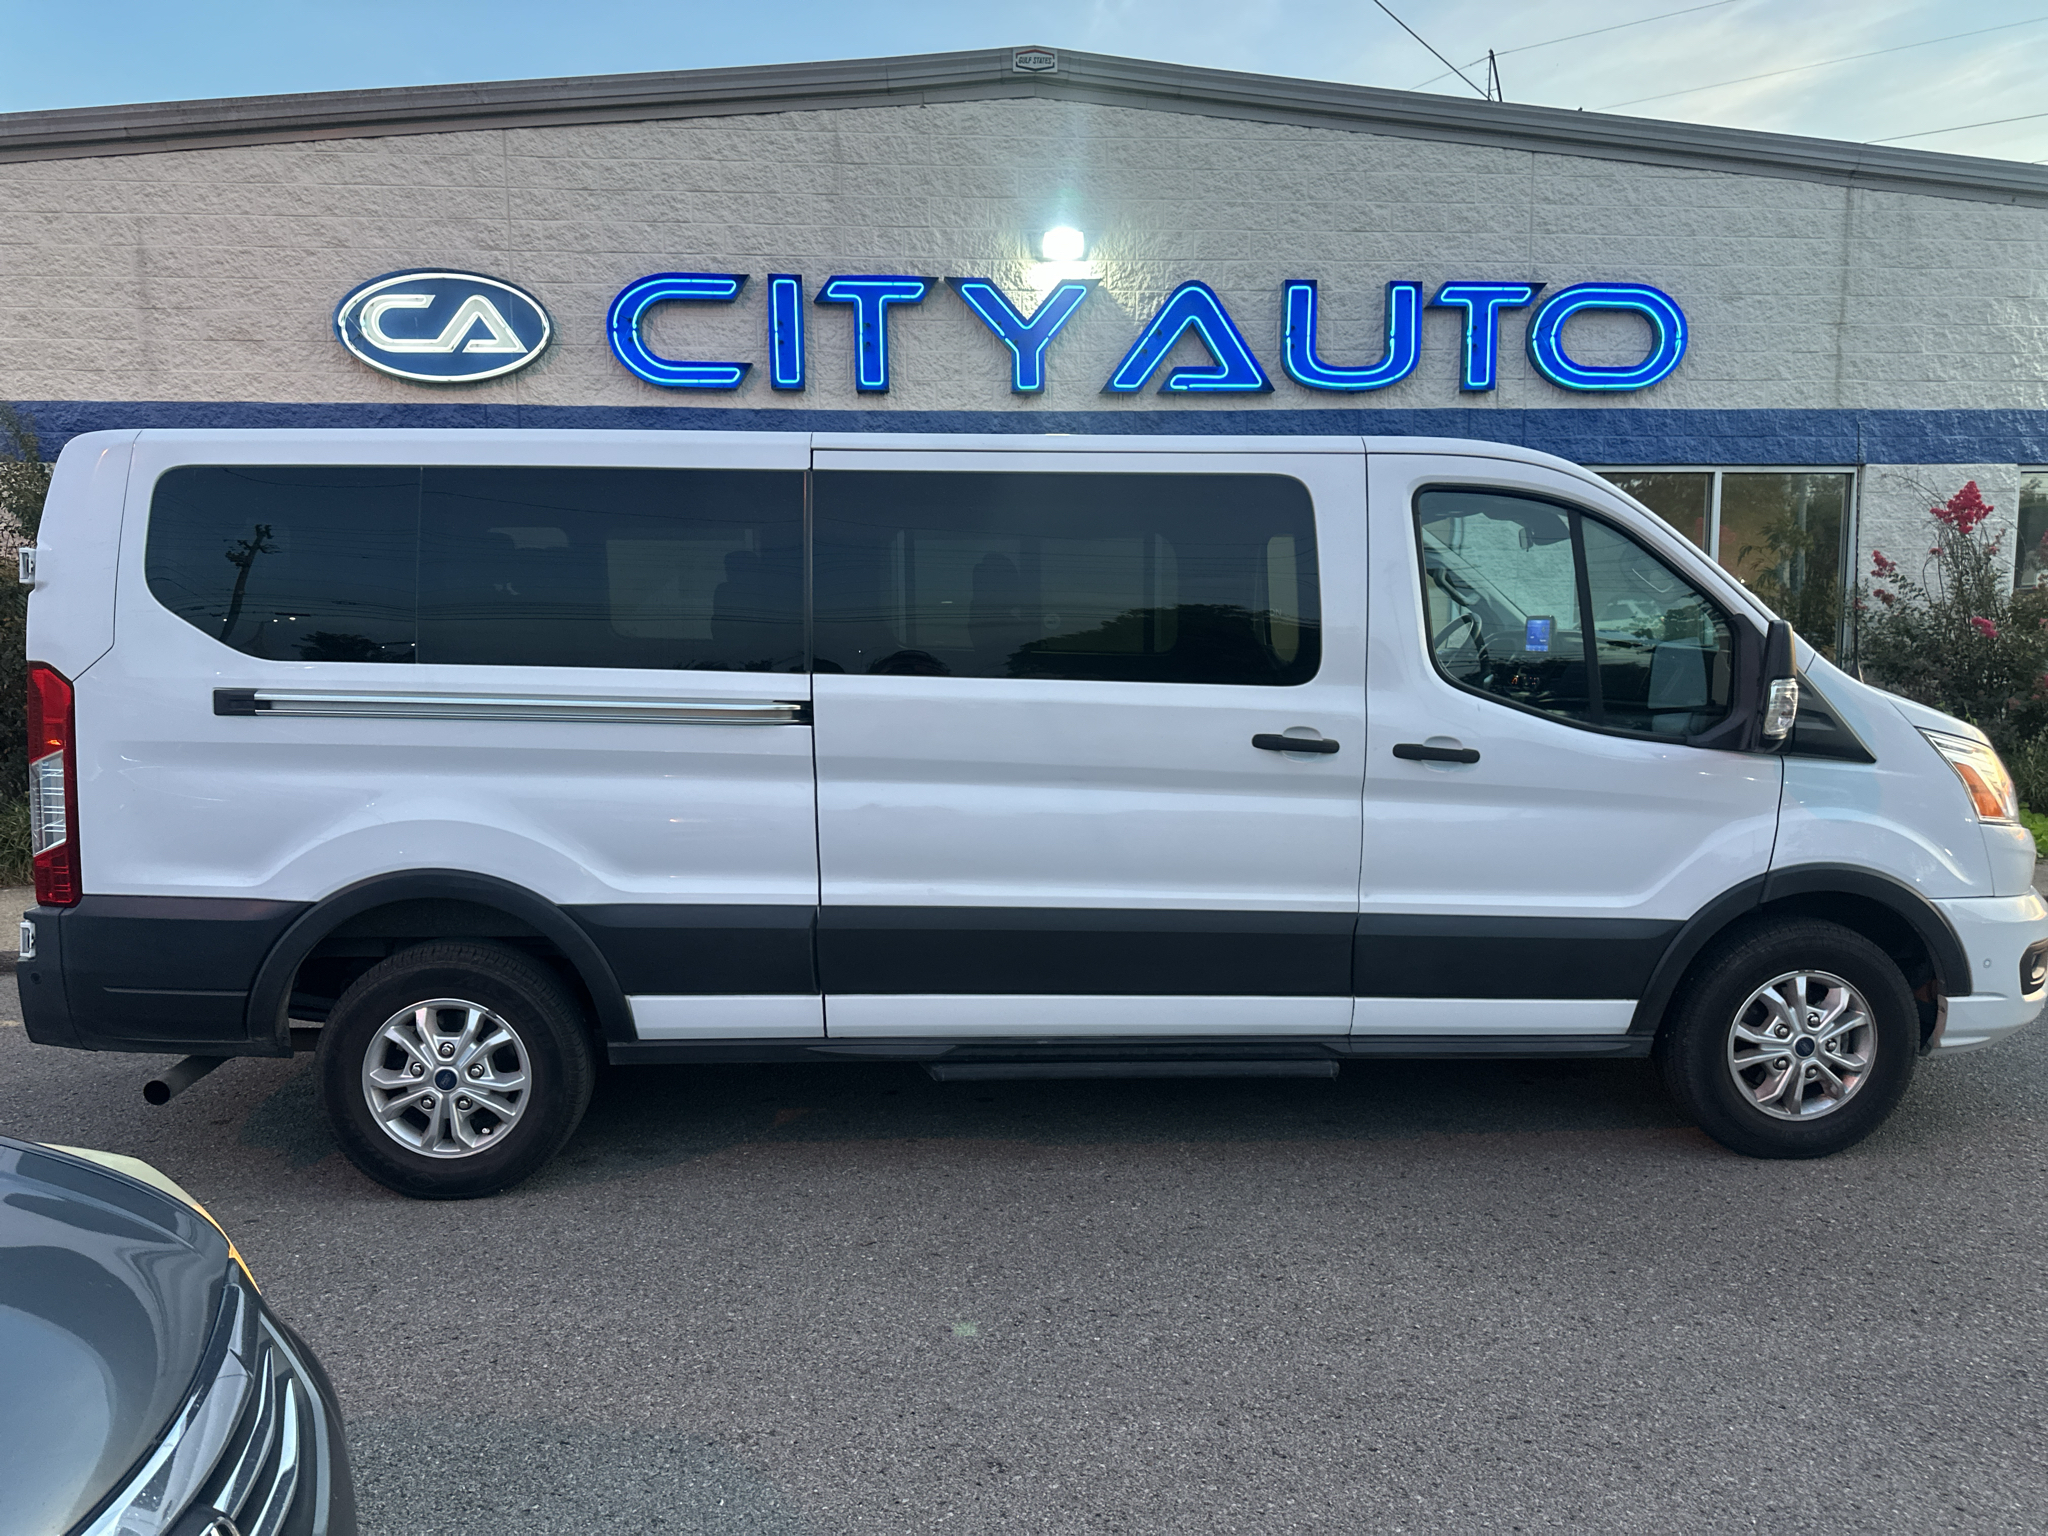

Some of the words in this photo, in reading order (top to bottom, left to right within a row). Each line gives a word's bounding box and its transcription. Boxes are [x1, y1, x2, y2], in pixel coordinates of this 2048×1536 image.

[1018, 56, 1031, 64] GULF
[1033, 56, 1052, 65] STATES
[358, 293, 530, 354] CA
[606, 273, 1099, 394] CITY
[1101, 278, 1690, 394] AUTO
